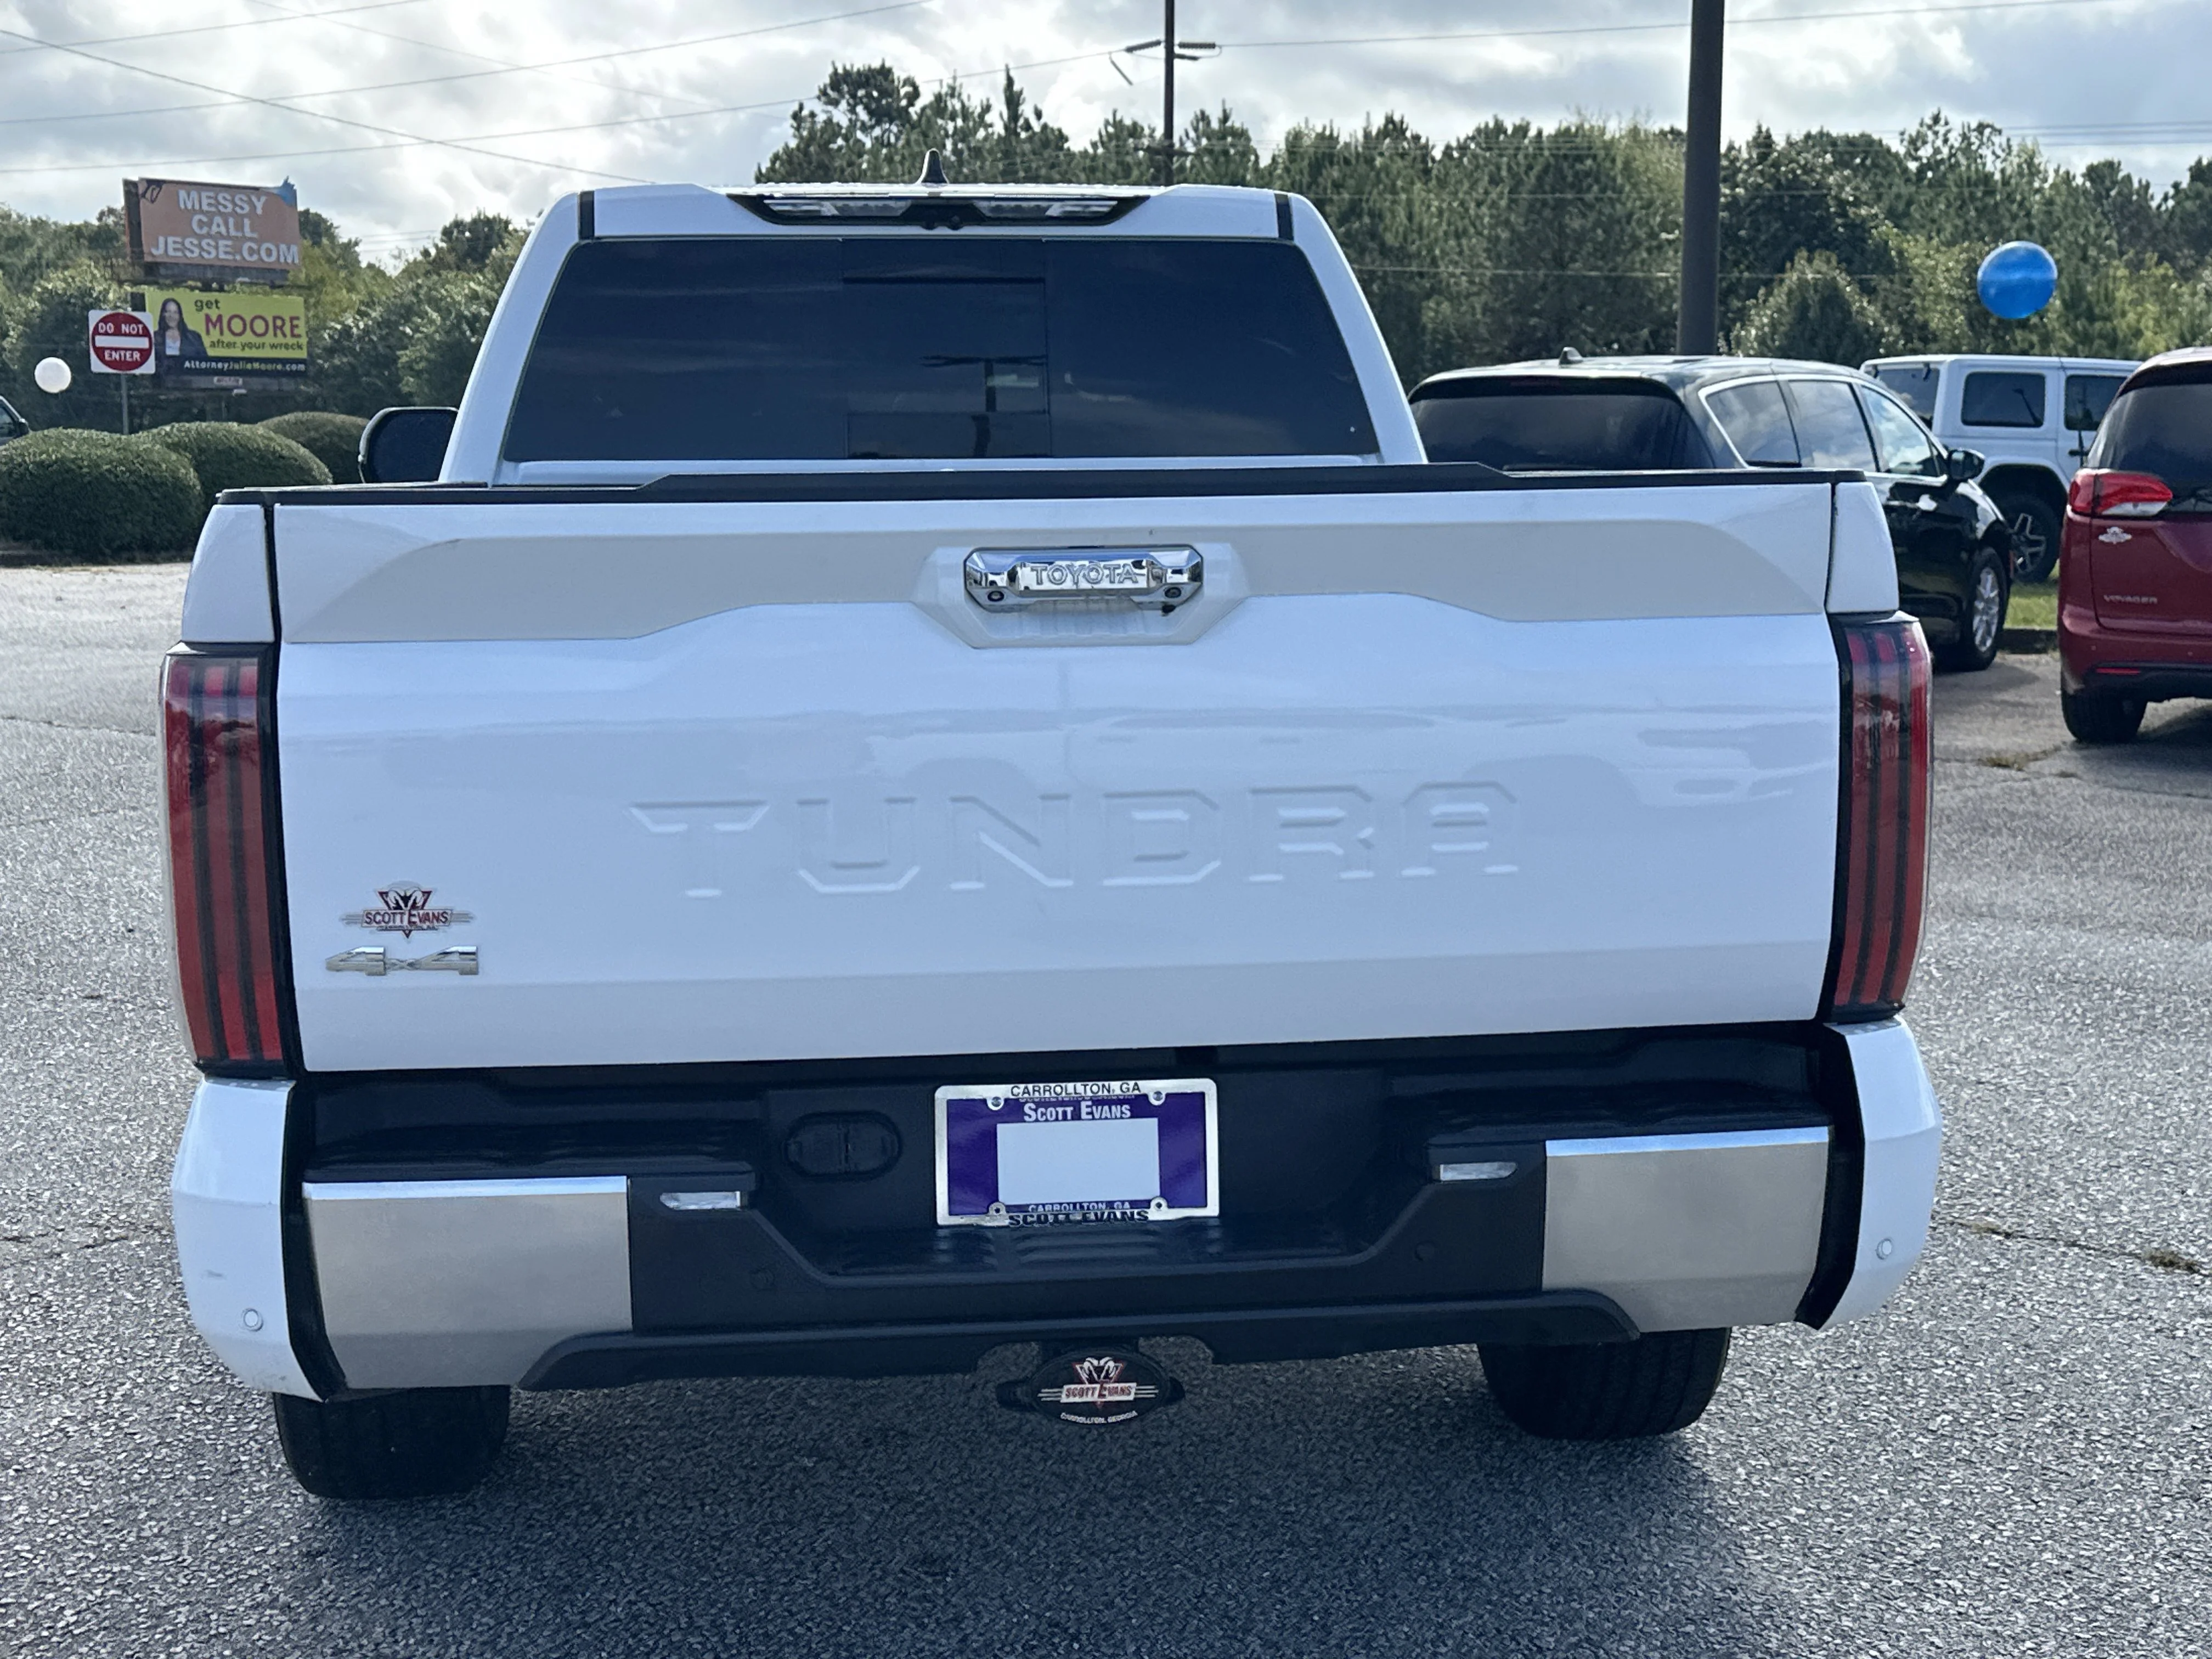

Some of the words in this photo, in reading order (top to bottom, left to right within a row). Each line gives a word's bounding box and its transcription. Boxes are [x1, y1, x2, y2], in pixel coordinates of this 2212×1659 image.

[178, 189, 267, 216] MESSY
[191, 214, 259, 238] CALL
[151, 236, 300, 265] JESSE.COM
[194, 298, 221, 312] get
[98, 323, 114, 334] DO
[122, 324, 144, 335] NOT
[205, 313, 302, 338] MOORE
[104, 350, 141, 362] ENTER
[210, 339, 238, 350] after
[240, 341, 267, 356] your
[269, 340, 303, 351] wreck
[1030, 563, 1139, 586] TOYOTA
[2103, 595, 2158, 604] VOYAGER
[630, 781, 1519, 898] TUNDRA
[364, 911, 405, 925] SCOTT
[408, 909, 449, 926] EVANS
[1119, 1081, 1142, 1094] GA
[1023, 1102, 1074, 1122] SCOTT
[1080, 1100, 1131, 1120] EVANS
[1008, 1212, 1073, 1227] SCOTT
[1081, 1209, 1149, 1224] EVANS
[1065, 1386, 1097, 1398] SCOTT
[1098, 1379, 1133, 1398] EVANS
